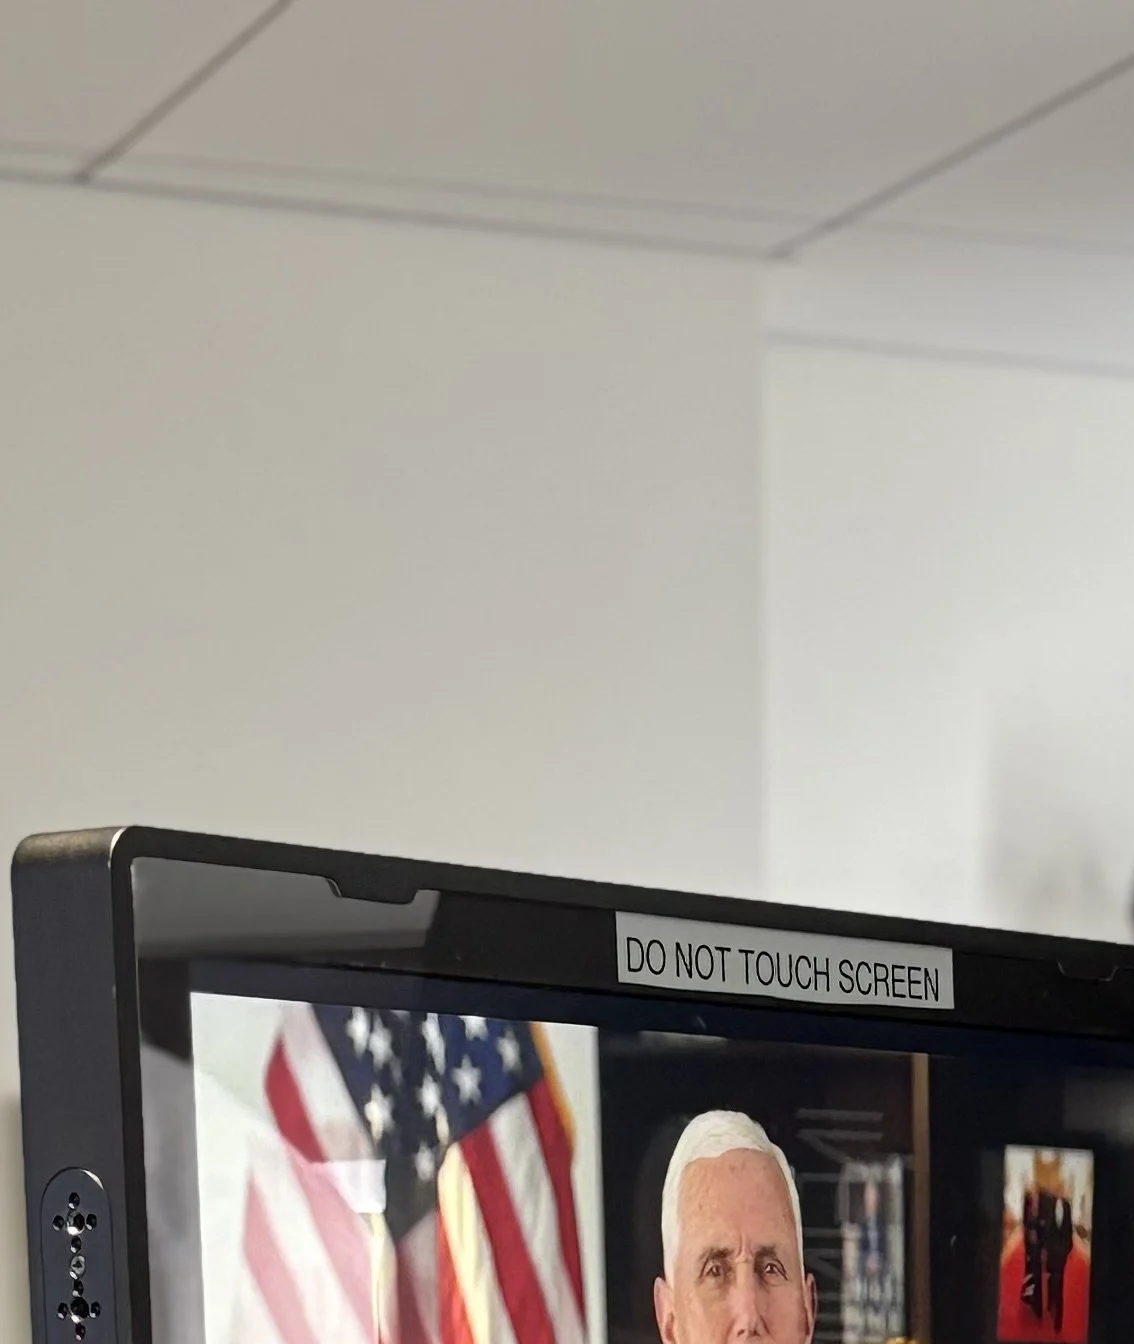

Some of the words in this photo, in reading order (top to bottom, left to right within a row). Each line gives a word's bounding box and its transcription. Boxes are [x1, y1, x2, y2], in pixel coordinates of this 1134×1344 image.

[626, 936, 666, 975] DO
[675, 942, 731, 982] NOT
[738, 949, 830, 992] TOUCH
[839, 959, 939, 1001] SCREEN
